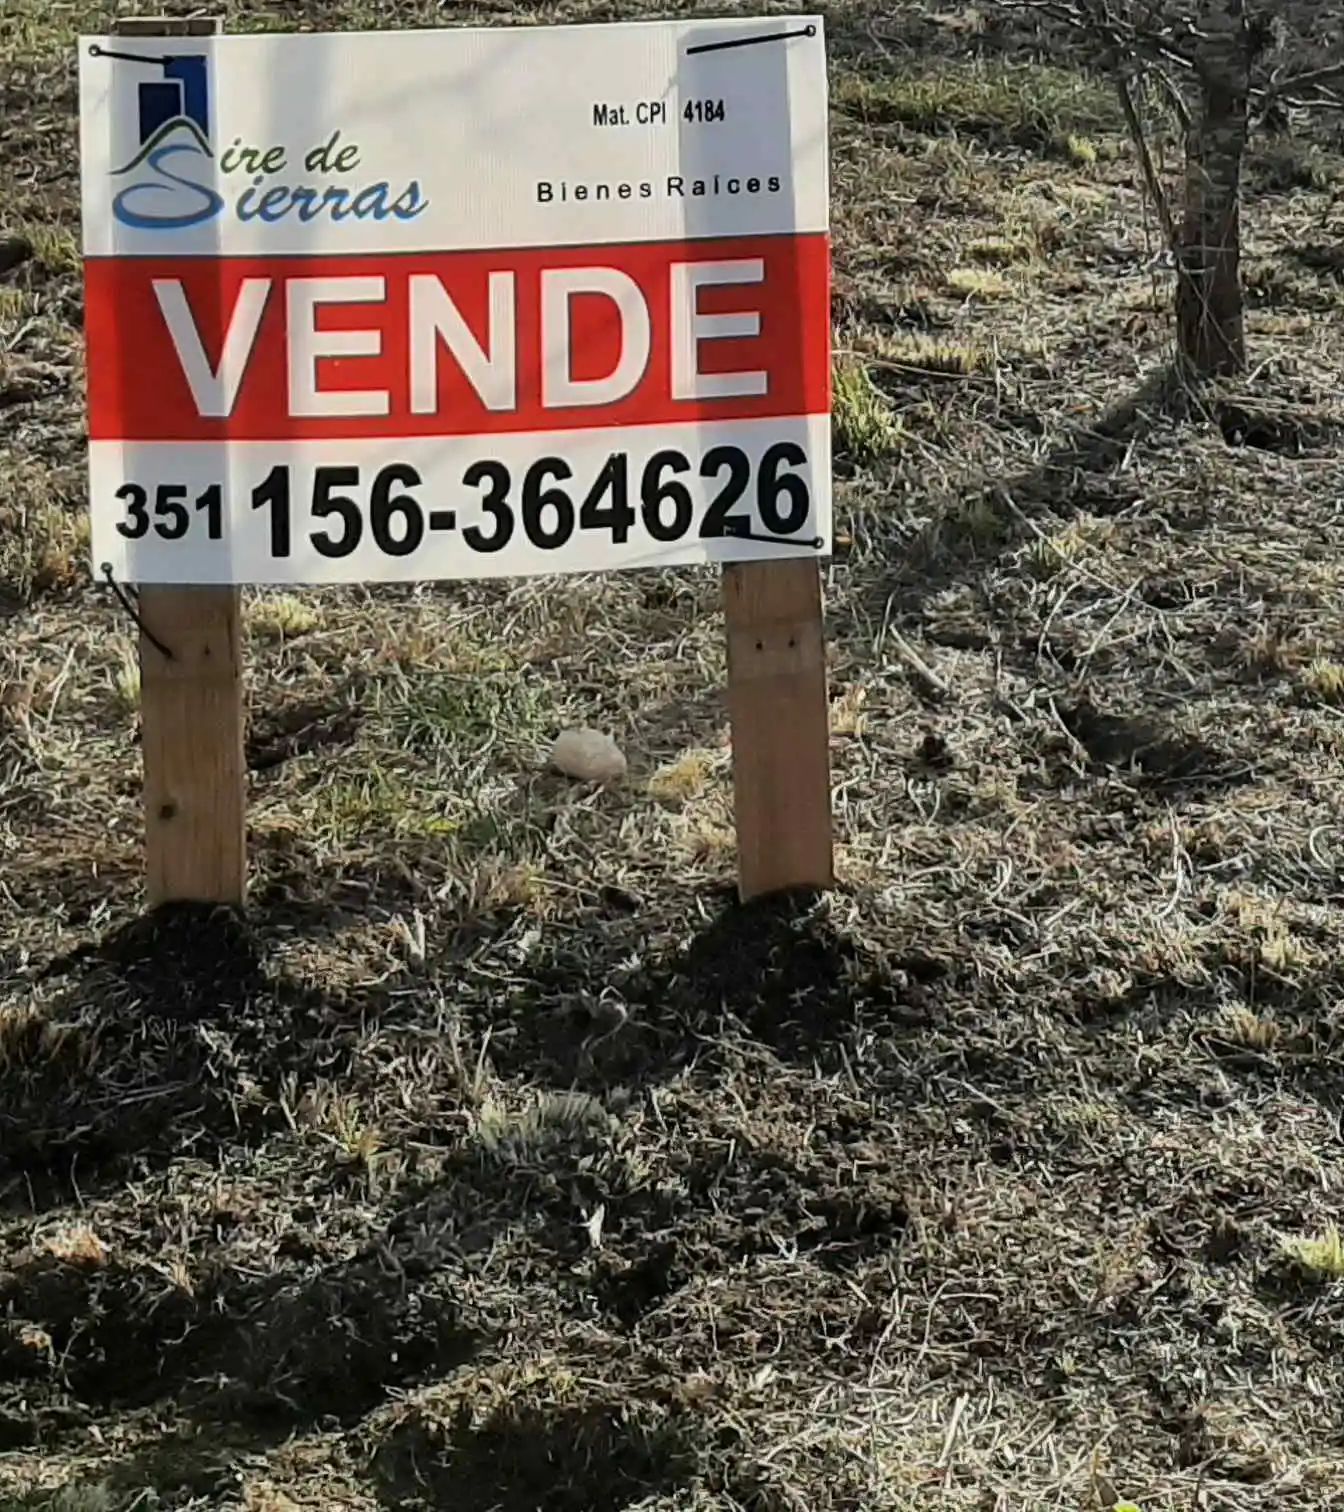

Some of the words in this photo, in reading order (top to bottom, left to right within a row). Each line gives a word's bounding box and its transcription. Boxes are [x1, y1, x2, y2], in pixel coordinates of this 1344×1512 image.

[592, 102, 630, 126] Mat.
[635, 101, 667, 124] CPI
[683, 99, 725, 123] 4184
[305, 130, 361, 172] de
[111, 143, 429, 230] Sierras
[536, 181, 653, 203] Bienes
[151, 259, 768, 418] VENDE
[115, 483, 223, 540] 351
[251, 442, 811, 557] 156-364626
